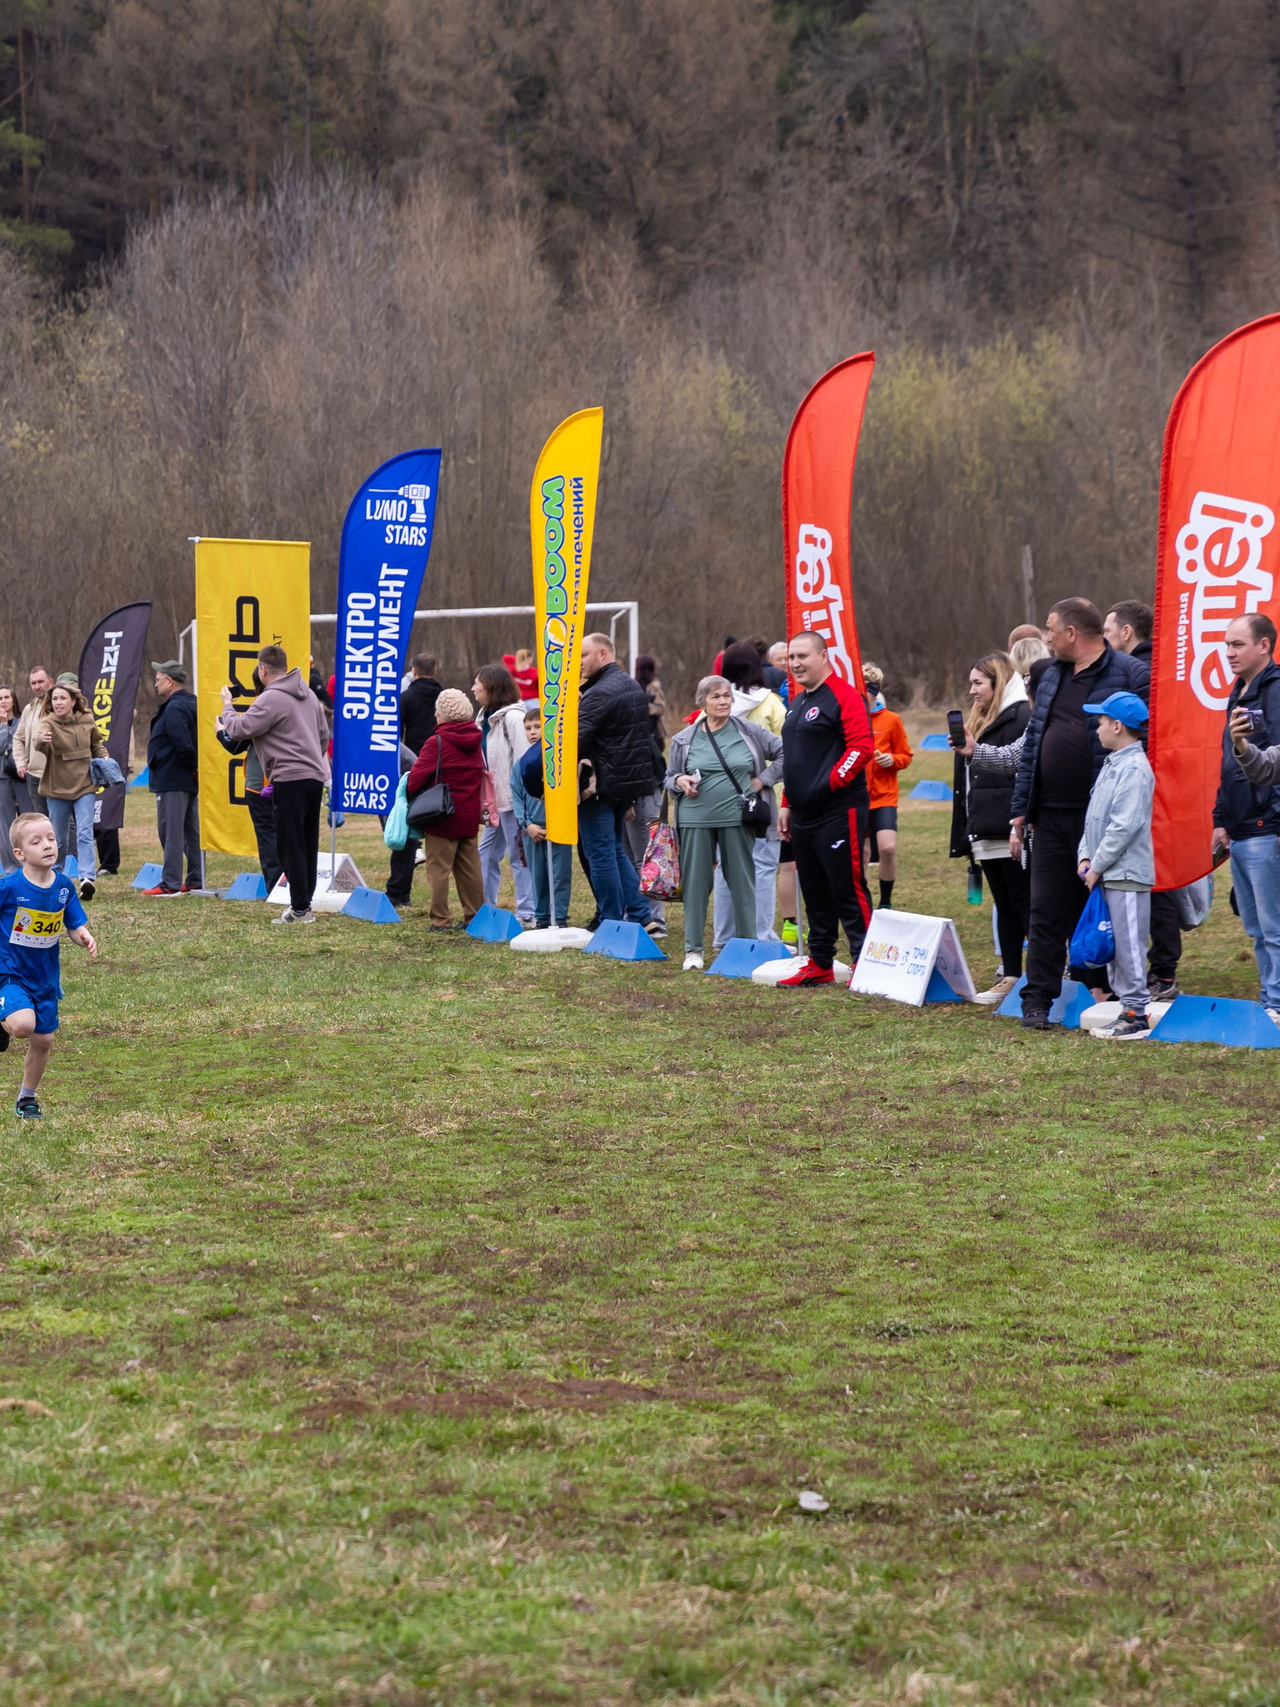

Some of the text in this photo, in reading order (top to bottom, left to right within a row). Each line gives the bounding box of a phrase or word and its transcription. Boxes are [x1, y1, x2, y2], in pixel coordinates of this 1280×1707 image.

[366, 499, 407, 522] LUMO
[385, 524, 427, 547] STARS
[569, 477, 584, 615] развлечений
[566, 622, 576, 672] парк
[1176, 592, 1190, 681] пиццерия
[342, 592, 376, 720] ЭЛЕКТРО
[370, 563, 409, 752] ИНСТРУМЕНТ
[343, 772, 390, 792] LUMO
[342, 790, 388, 810] STARS
[32, 920, 60, 934] 340
[866, 941, 900, 962] РАДОСТЬ
